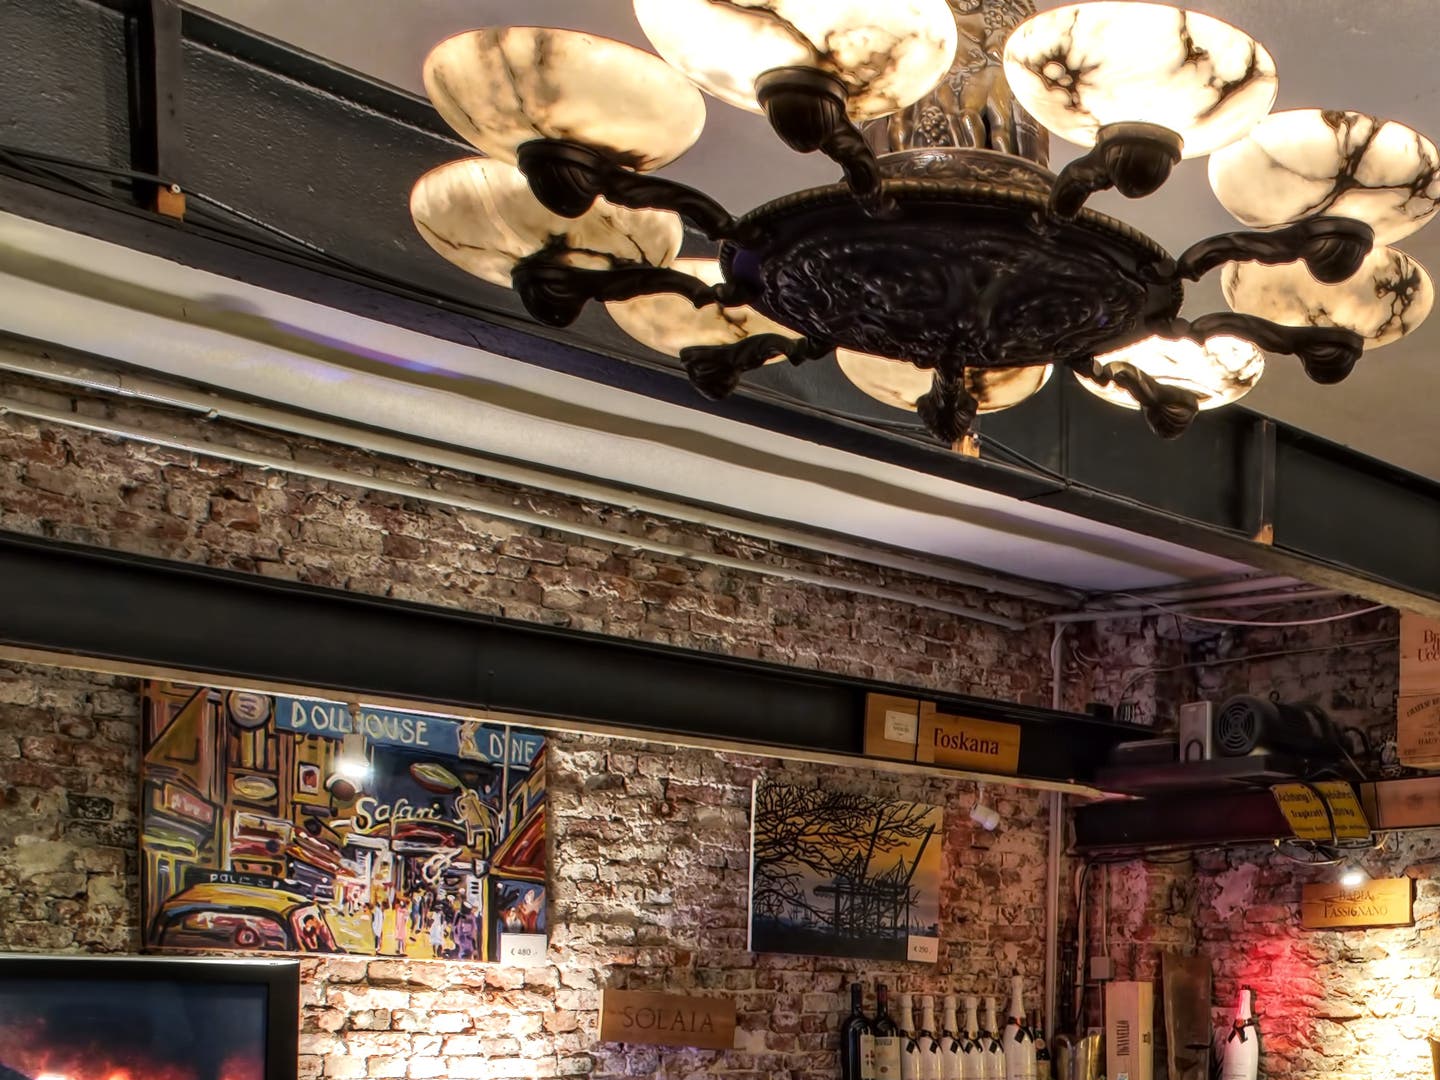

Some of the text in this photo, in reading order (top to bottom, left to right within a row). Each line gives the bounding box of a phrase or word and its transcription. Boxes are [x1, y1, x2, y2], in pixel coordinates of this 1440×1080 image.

[489, 732, 537, 763] DNE
[934, 727, 1000, 755] Toskana
[351, 797, 442, 834] Safari
[622, 1005, 714, 1032] SOLAIA
